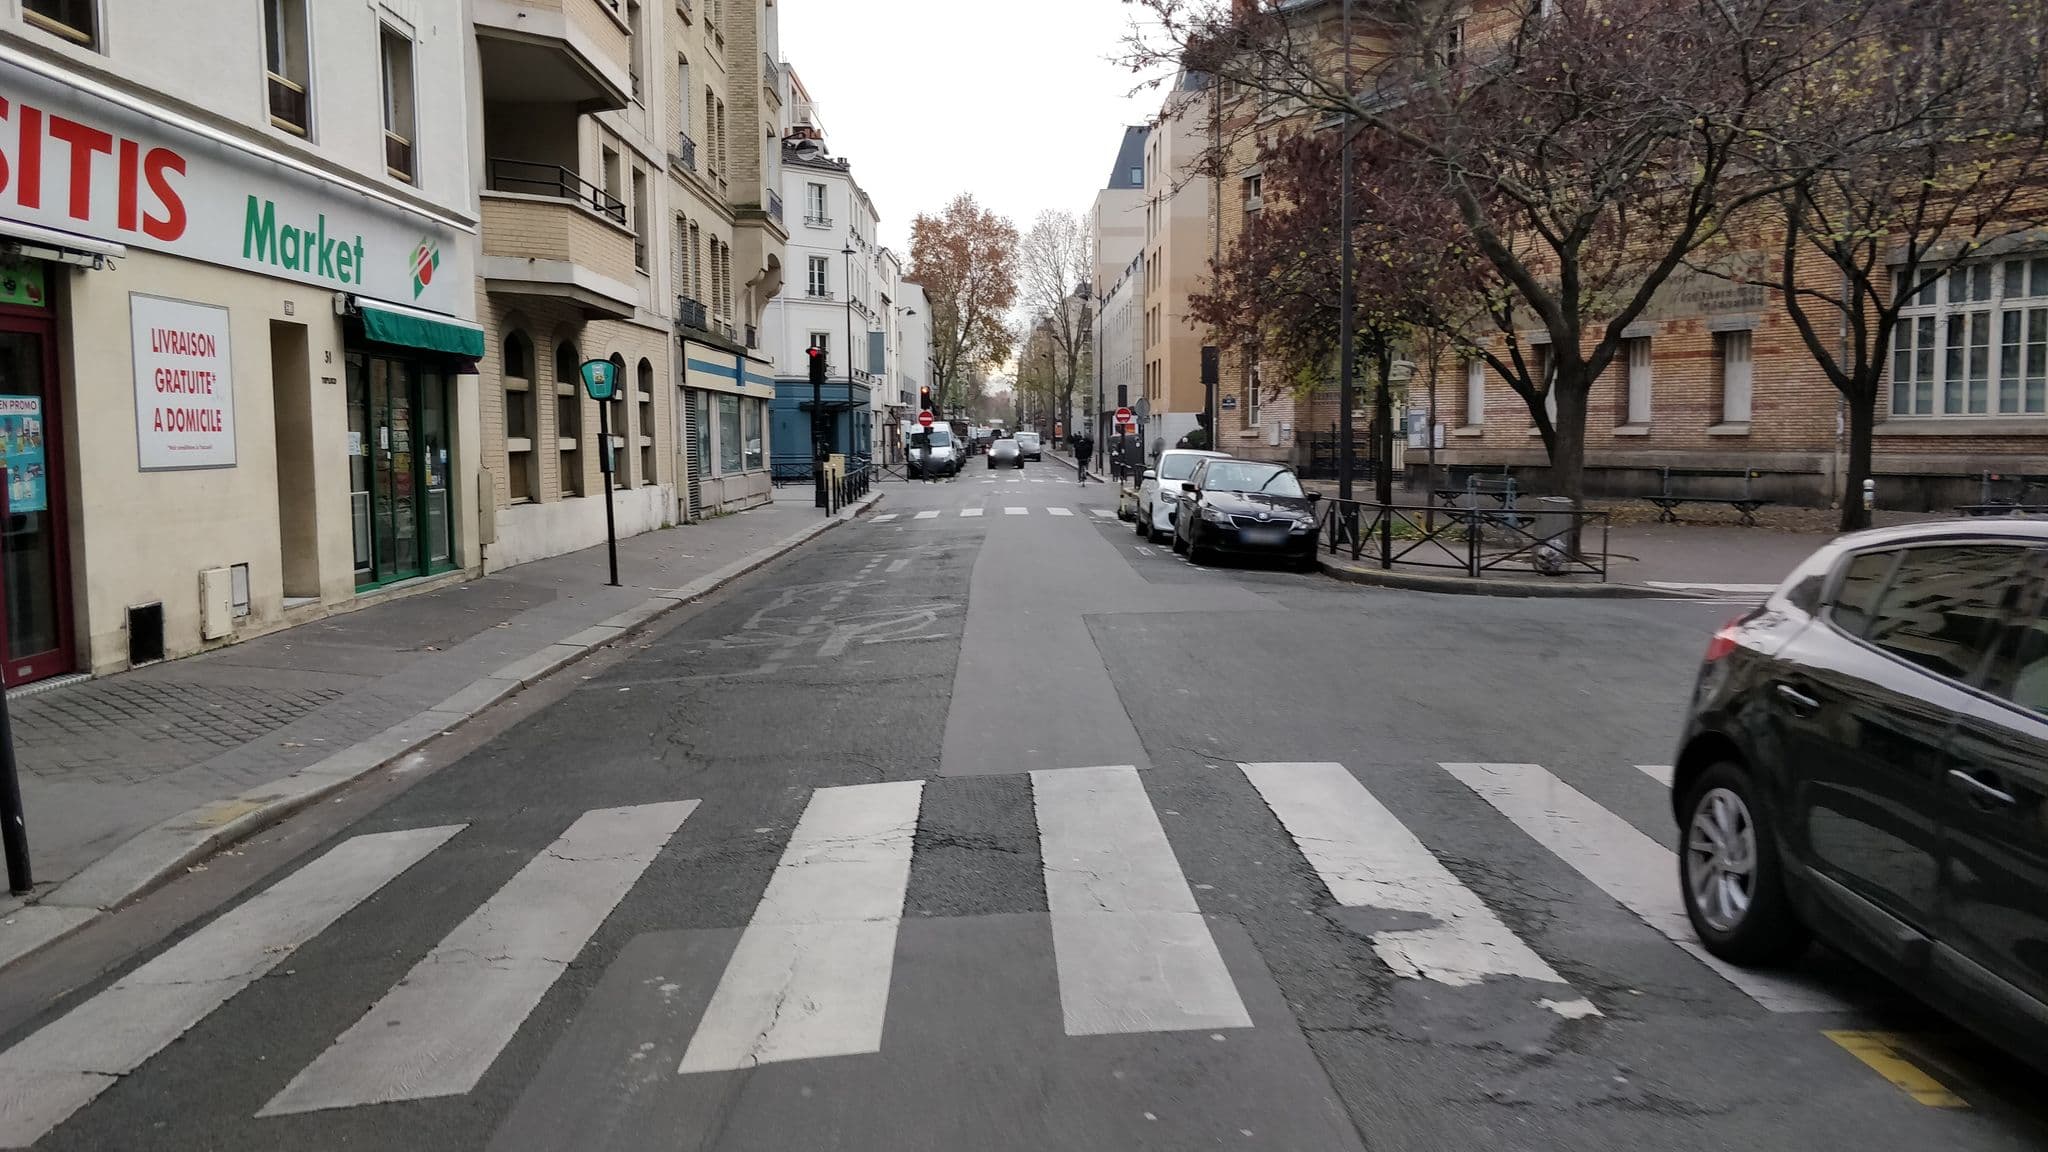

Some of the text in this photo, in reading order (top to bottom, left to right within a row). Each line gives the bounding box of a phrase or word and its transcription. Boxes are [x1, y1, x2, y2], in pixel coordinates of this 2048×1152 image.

[0, 96, 187, 242] ITIS
[242, 194, 364, 285] Market
[151, 328, 216, 358] LIVRAISON
[10, 400, 37, 410] PROMO
[154, 407, 222, 432] A DOMICILE
